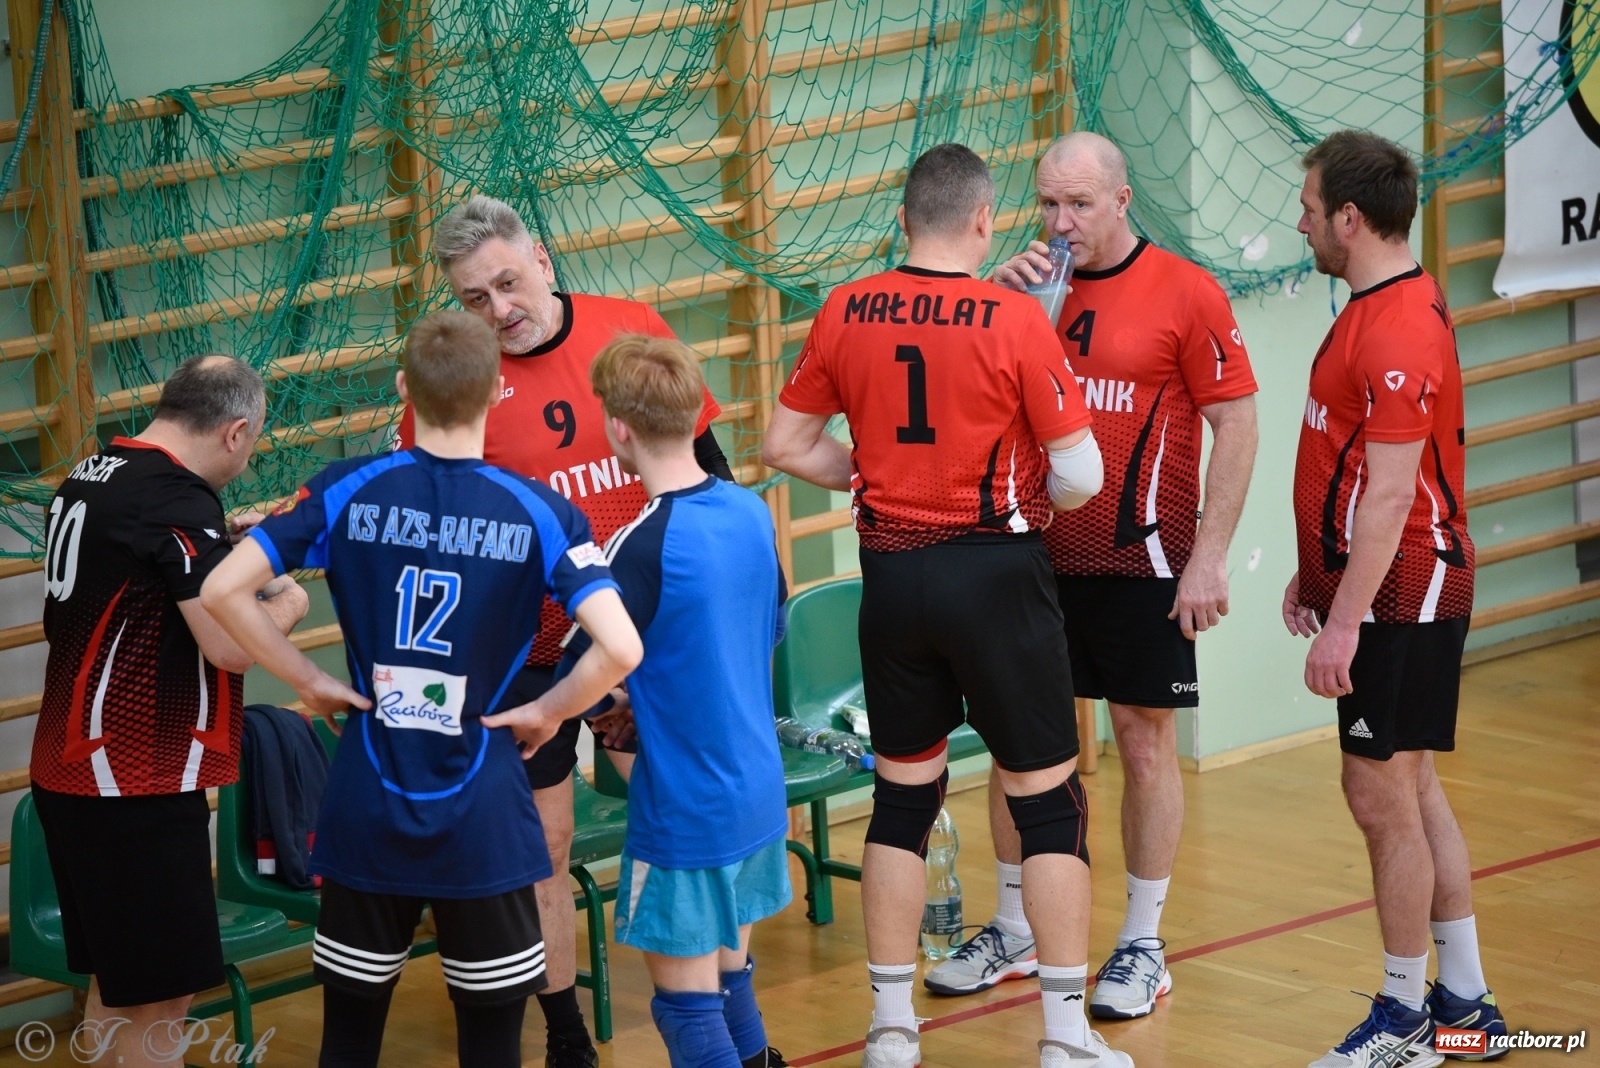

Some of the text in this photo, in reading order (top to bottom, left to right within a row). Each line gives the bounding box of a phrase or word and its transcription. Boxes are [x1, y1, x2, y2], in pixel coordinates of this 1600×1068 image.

[844, 292, 1001, 329] MAŁOLAT
[1065, 309, 1096, 357] 4
[894, 344, 936, 445] 1
[542, 400, 577, 449] 9
[529, 455, 642, 501] OTNI
[348, 503, 533, 563] KS AZS-RAFAKO
[395, 565, 462, 657] 12
[1348, 729, 1374, 739] adidas
